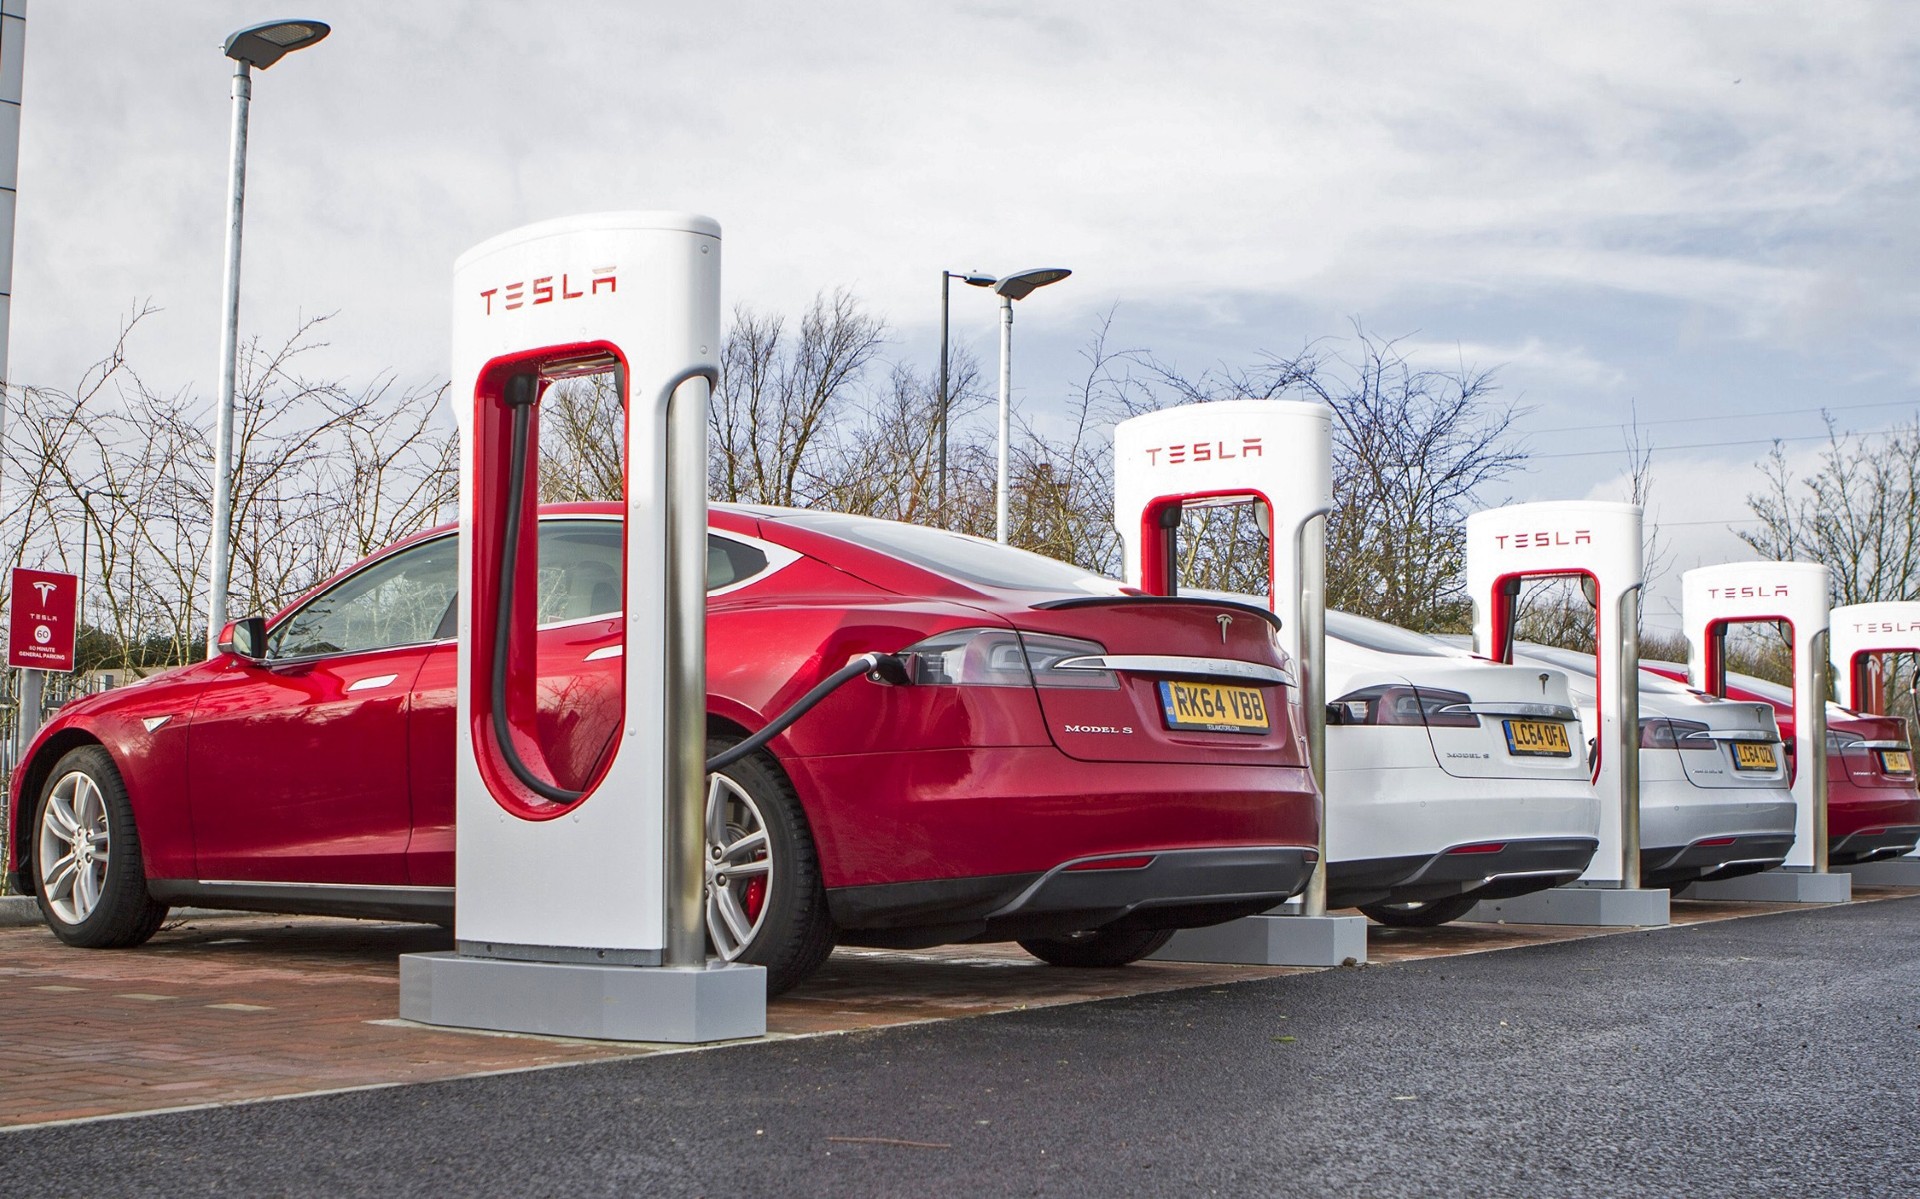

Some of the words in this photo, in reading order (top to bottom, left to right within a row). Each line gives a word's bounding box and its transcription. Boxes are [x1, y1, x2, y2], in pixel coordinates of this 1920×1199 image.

[480, 266, 617, 316] TESLA
[1145, 438, 1262, 466] TESLA
[1495, 530, 1591, 549] TESLA
[1708, 585, 1788, 599] TESLA
[30, 612, 58, 622] TESLA
[36, 629, 49, 639] 60
[1853, 622, 1920, 633] TESLA
[1174, 686, 1226, 718] RK64
[1227, 690, 1264, 721] VBB
[1065, 725, 1119, 734] MODEL
[1122, 726, 1133, 734] S
[1512, 723, 1544, 746] LC64
[1544, 725, 1567, 747] OFA
[1737, 745, 1759, 762] LC64
